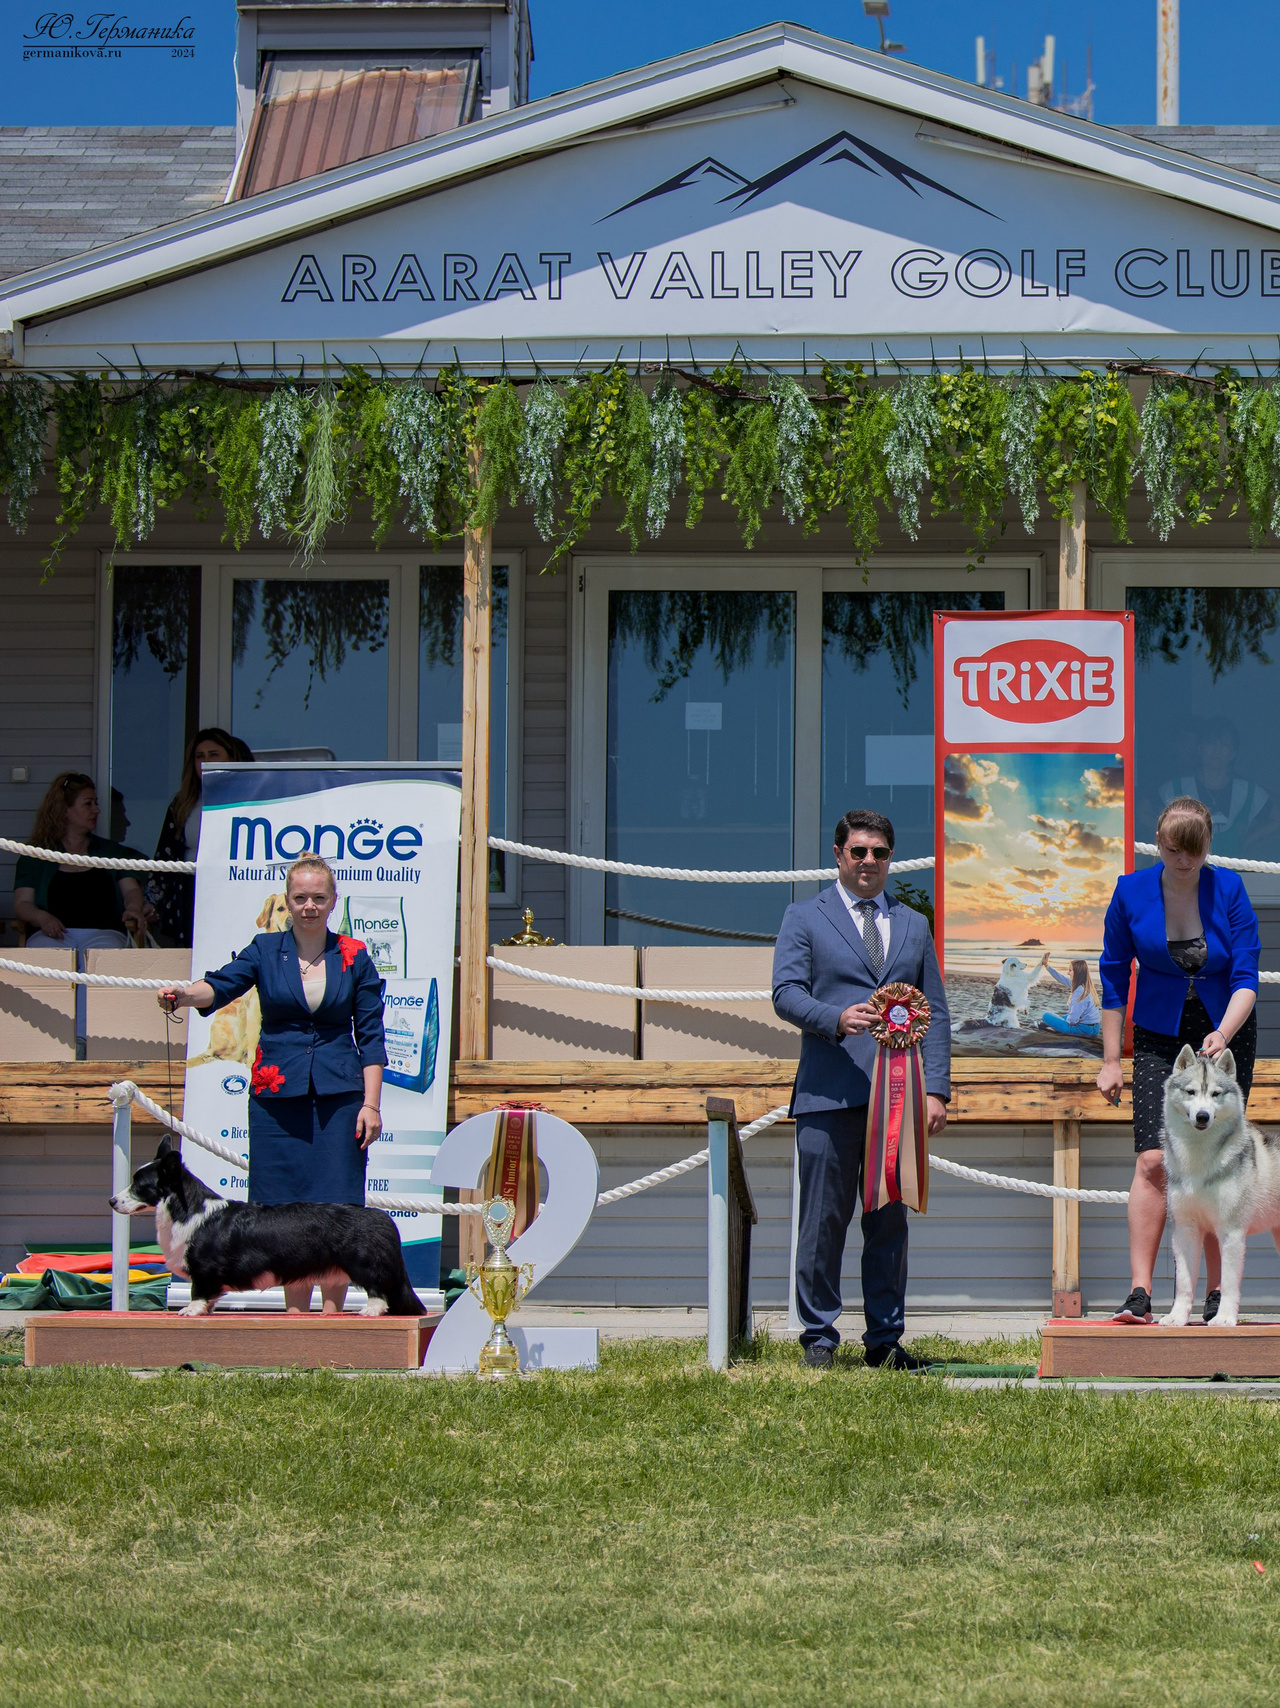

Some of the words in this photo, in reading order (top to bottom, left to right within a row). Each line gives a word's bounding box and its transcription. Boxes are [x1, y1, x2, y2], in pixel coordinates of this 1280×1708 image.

[281, 252, 572, 302] ARARAT
[597, 250, 863, 299] VALLEY
[891, 248, 1086, 298] GOLF
[229, 865, 276, 881] Natural
[376, 865, 421, 885] Quality
[367, 1178, 390, 1191] FREE
[423, 1110, 600, 1370] 2
